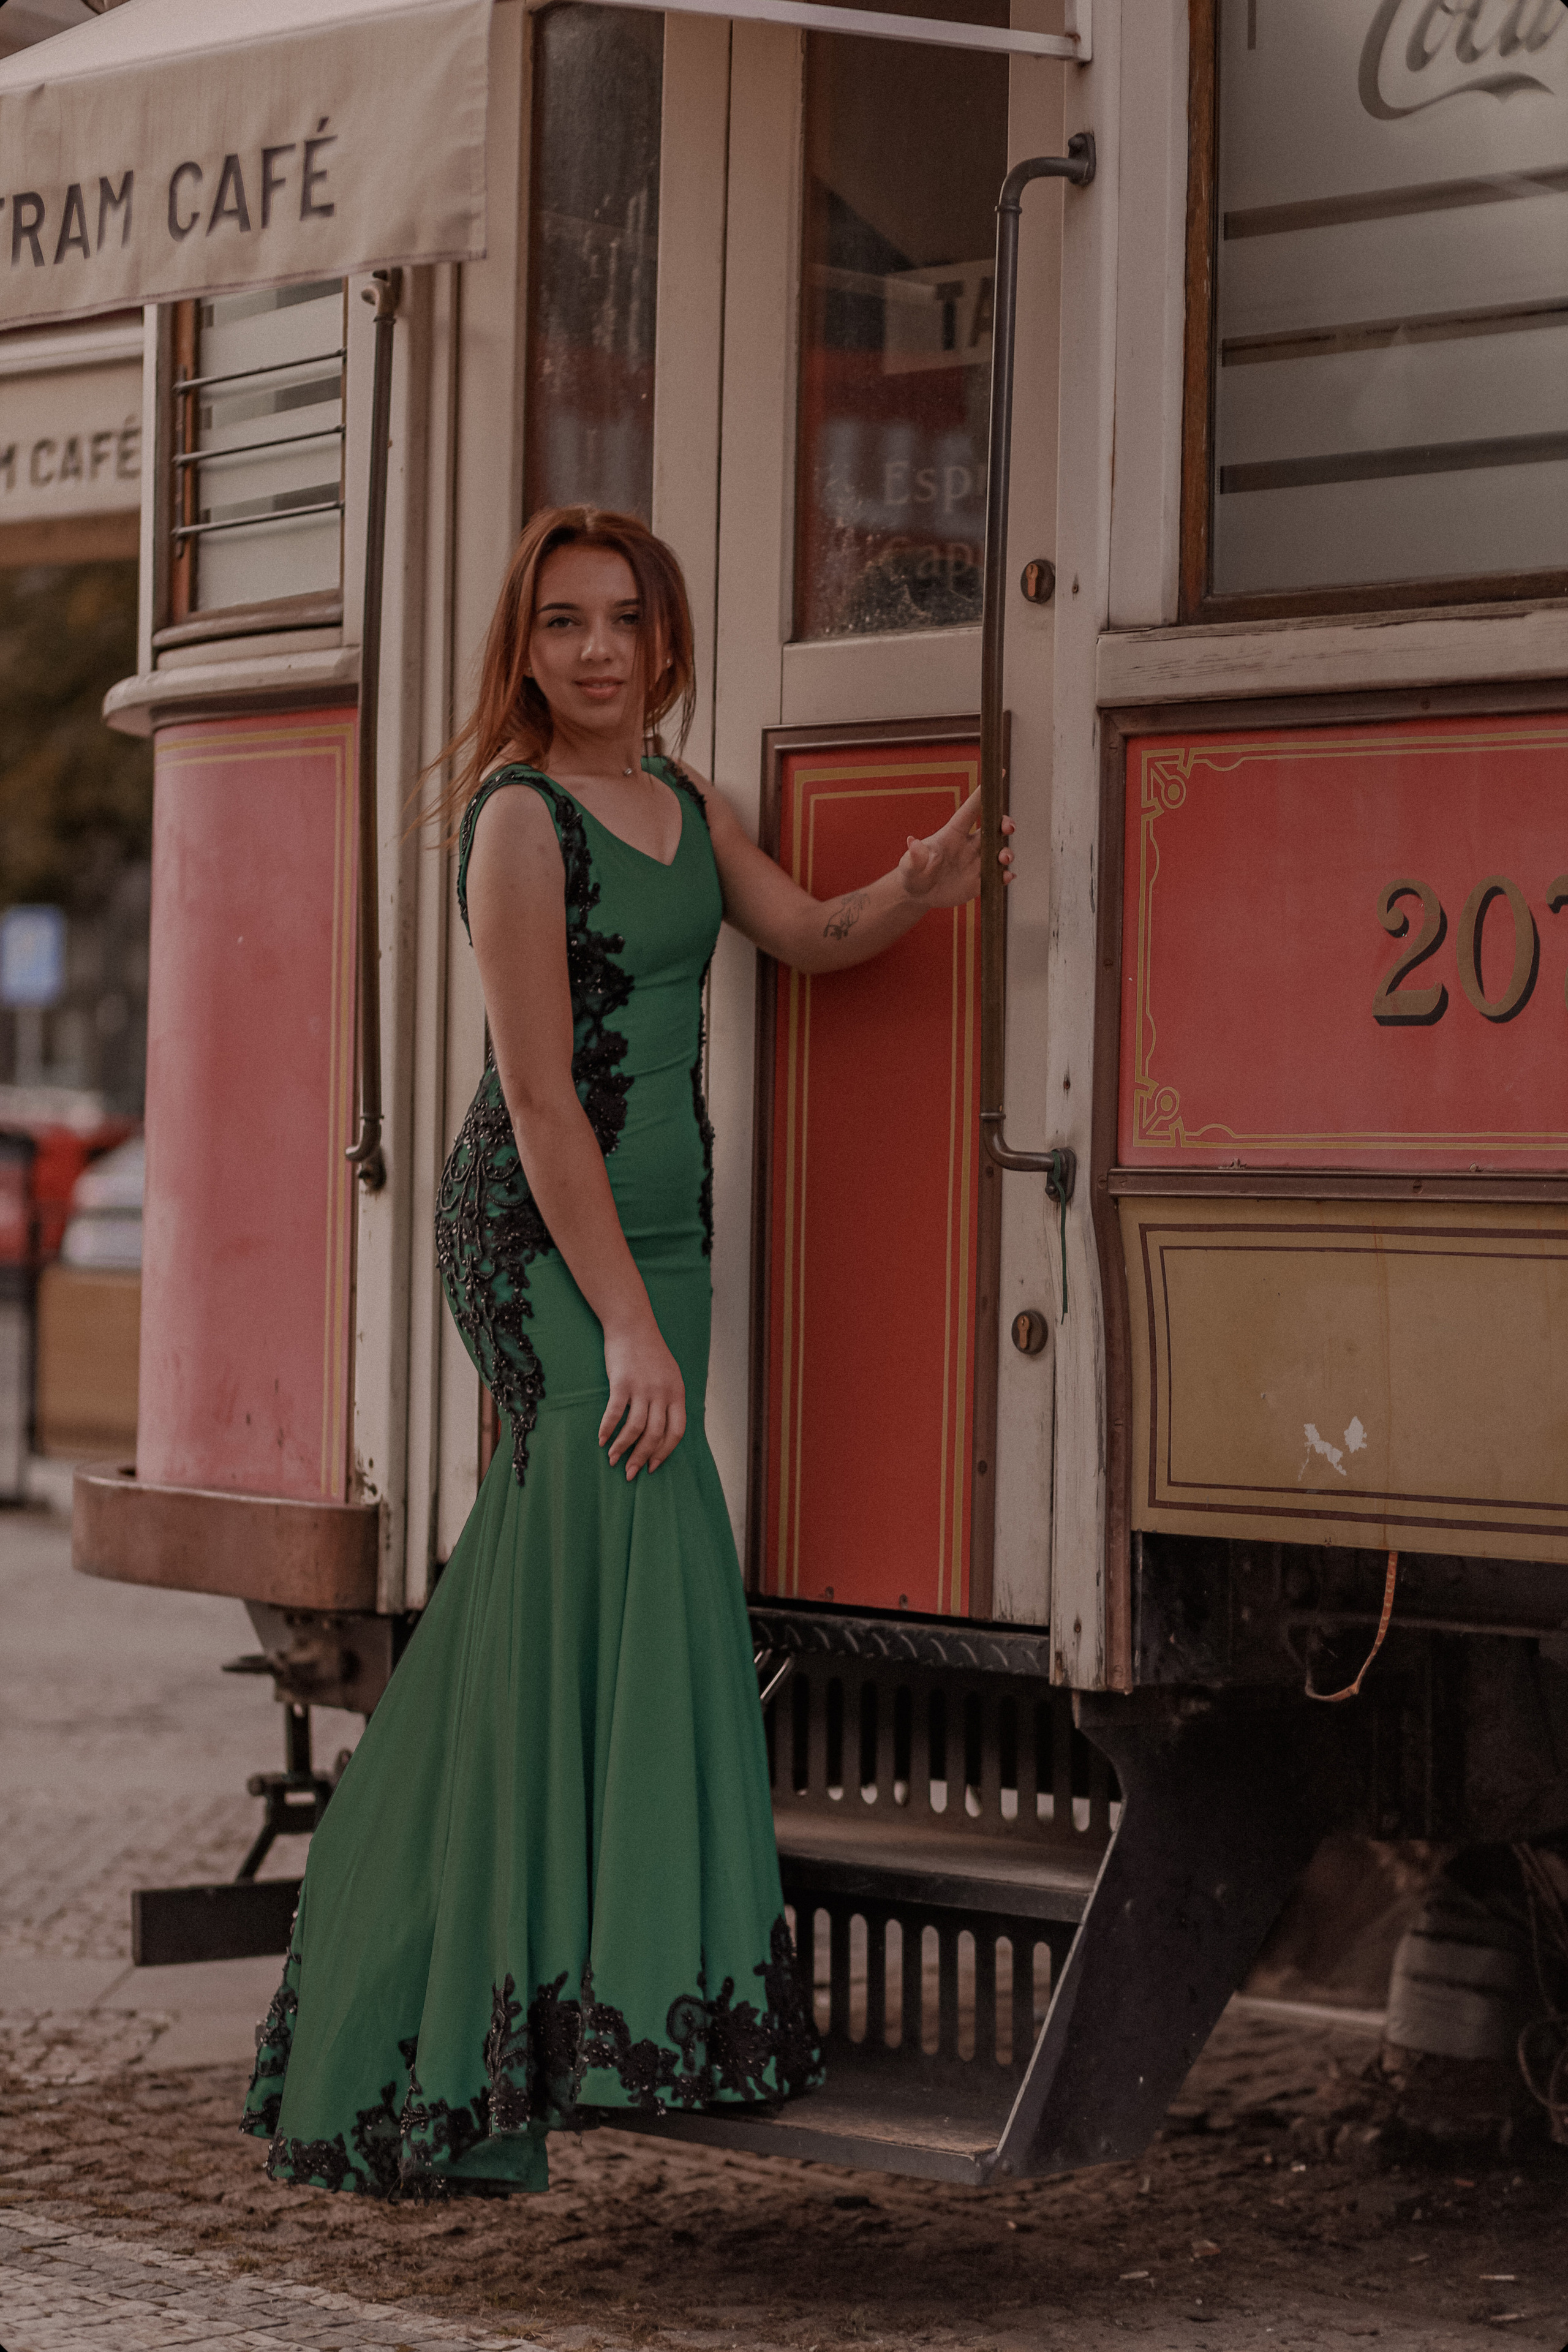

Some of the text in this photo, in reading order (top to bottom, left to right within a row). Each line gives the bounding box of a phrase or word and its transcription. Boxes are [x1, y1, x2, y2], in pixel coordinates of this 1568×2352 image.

[0, 116, 338, 267] RAM CAFÉ
[30, 413, 141, 487] CAFÉ
[883, 461, 987, 514] Esp
[879, 537, 984, 591] Cap
